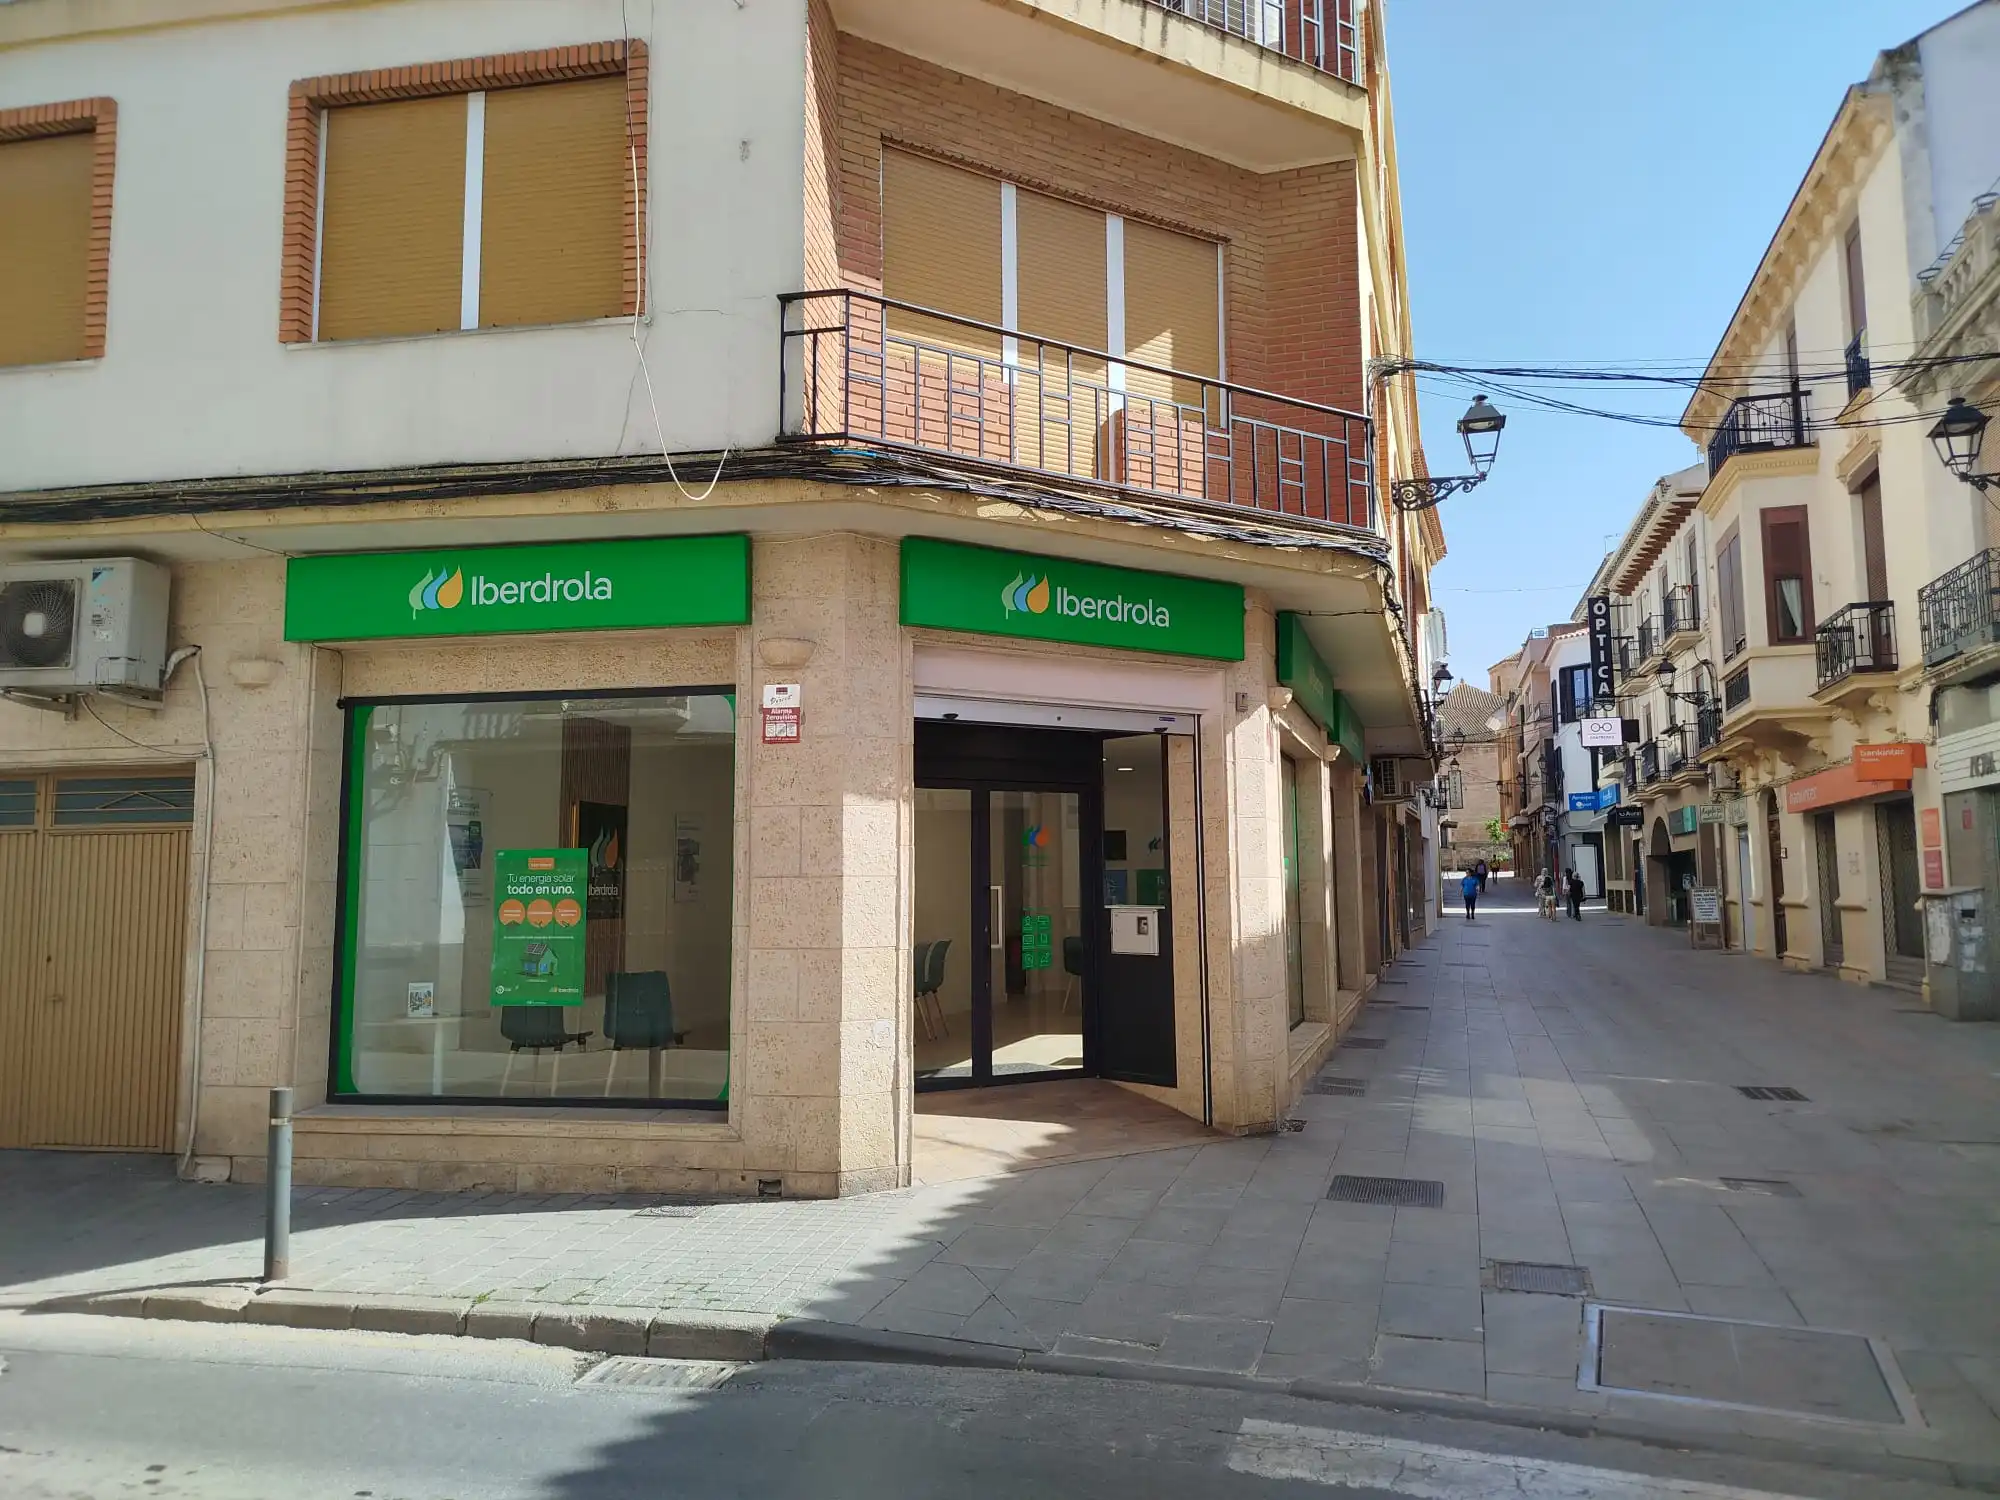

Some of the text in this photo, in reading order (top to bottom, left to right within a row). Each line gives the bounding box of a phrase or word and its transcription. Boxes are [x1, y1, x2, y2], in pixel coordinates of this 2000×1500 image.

[471, 570, 612, 606] Iberdrola
[1056, 586, 1170, 628] Iberdrola
[1593, 600, 1611, 695] ÓPTICA
[507, 873, 575, 885] Tu energía solar
[507, 884, 575, 895] todo en uno.
